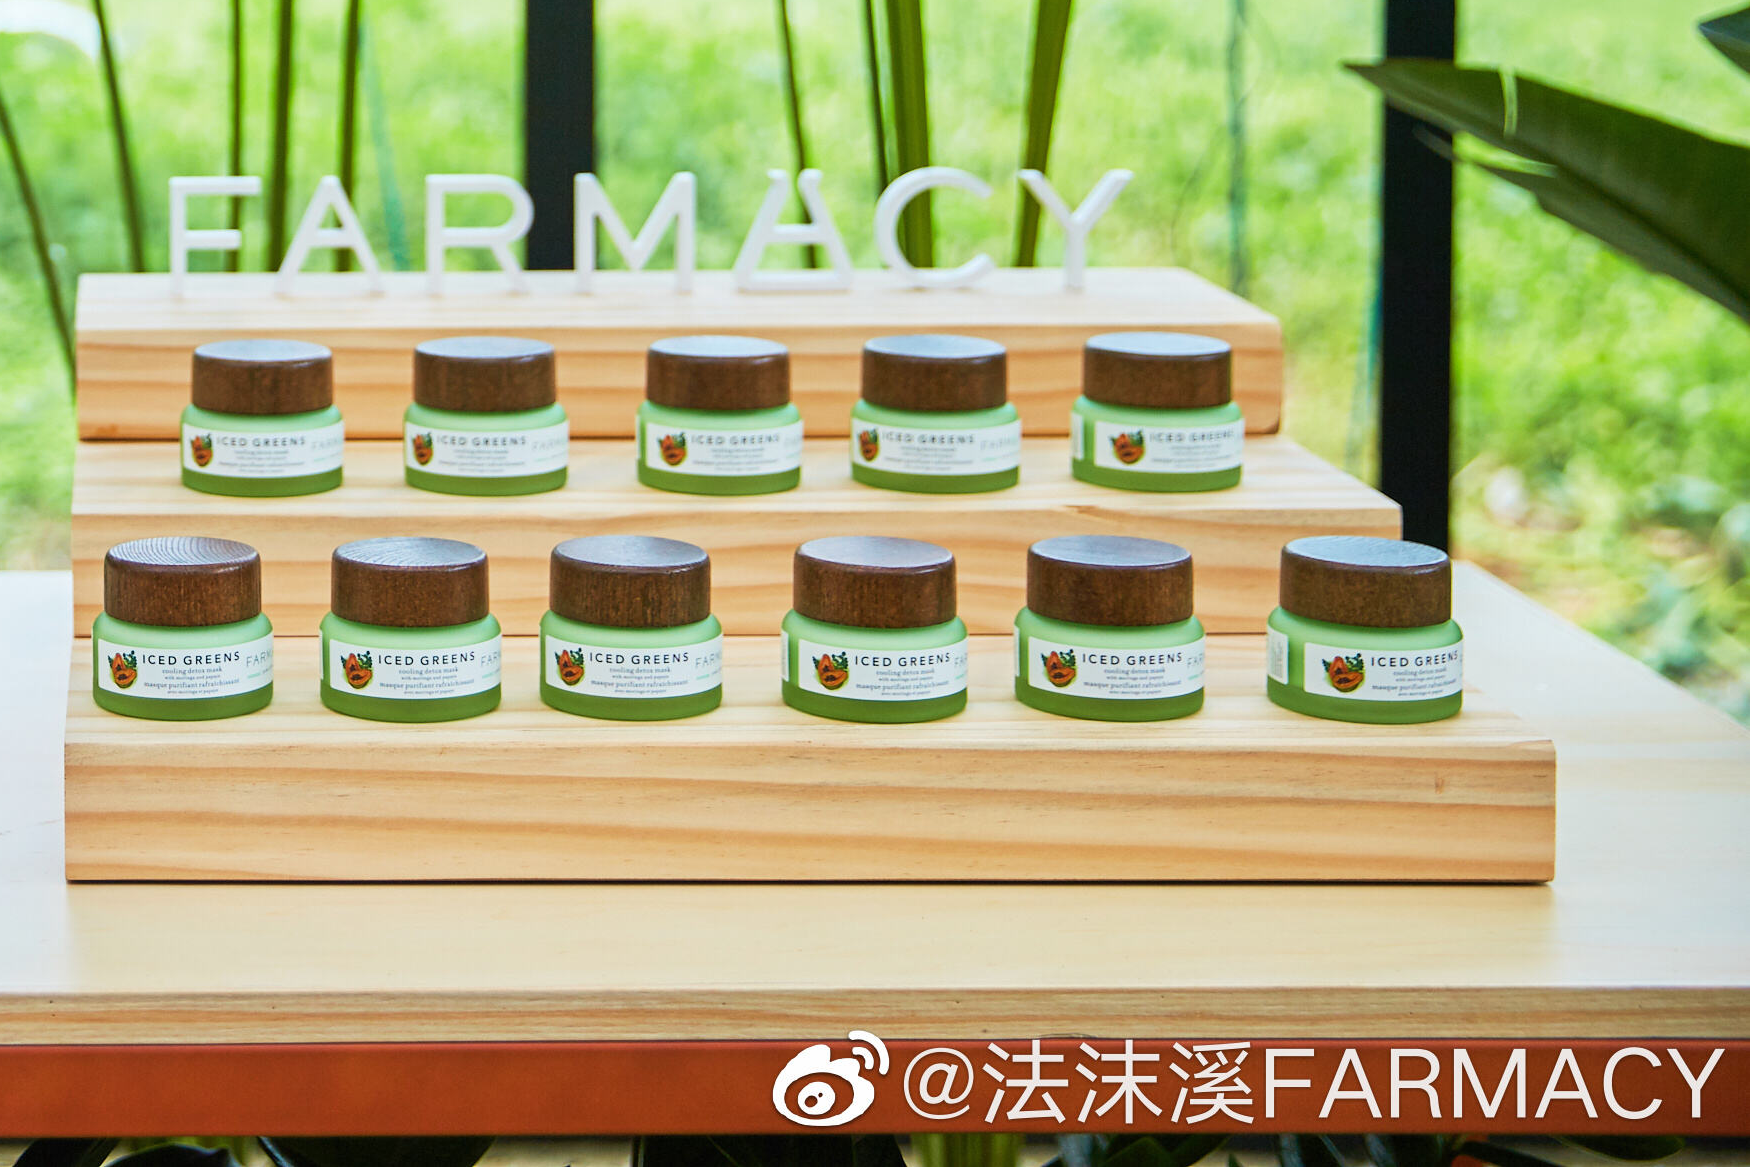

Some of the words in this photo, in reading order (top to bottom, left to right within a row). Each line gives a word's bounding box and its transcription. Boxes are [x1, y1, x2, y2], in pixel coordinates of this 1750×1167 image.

[168, 167, 1134, 296] FARMACY
[216, 436, 248, 447] ICED
[252, 436, 306, 447] GREENS
[437, 435, 467, 446] ICED
[471, 436, 527, 447] GREENS
[142, 654, 177, 666] ICED
[183, 651, 240, 666] GREENS
[378, 654, 414, 666] ICED
[420, 651, 475, 666] GREENS
[589, 652, 625, 664] ICED
[631, 652, 689, 665] GREENS
[855, 655, 892, 667] ICED
[898, 652, 950, 667] GREENS
[1082, 653, 1120, 665] ICED
[1127, 652, 1183, 666] GREENS
[1371, 656, 1409, 667] ICED
[1415, 650, 1458, 667] GREENS
